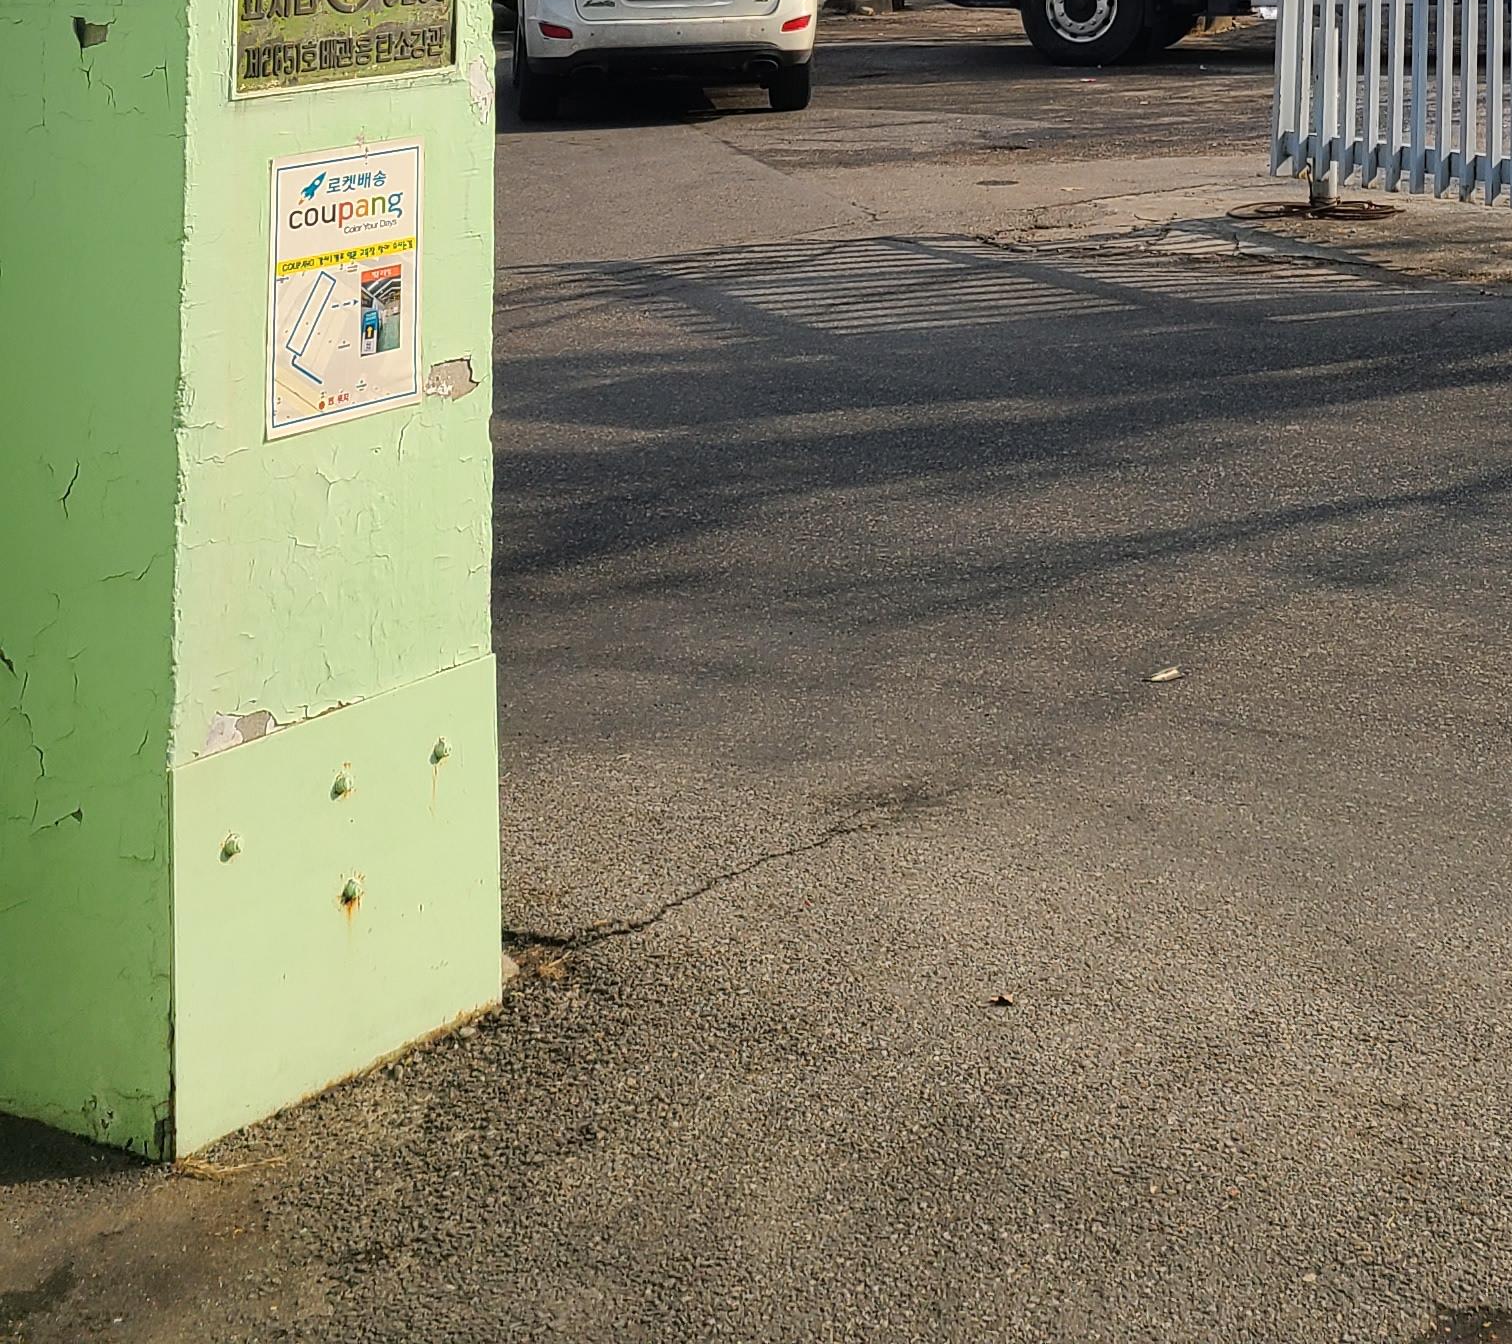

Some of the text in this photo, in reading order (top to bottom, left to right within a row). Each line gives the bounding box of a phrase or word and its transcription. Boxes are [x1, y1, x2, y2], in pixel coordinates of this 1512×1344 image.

[326, 170, 387, 194] 로켓배송
[288, 191, 404, 230] coupang
[362, 221, 379, 231] Your
[379, 218, 398, 229] Days
